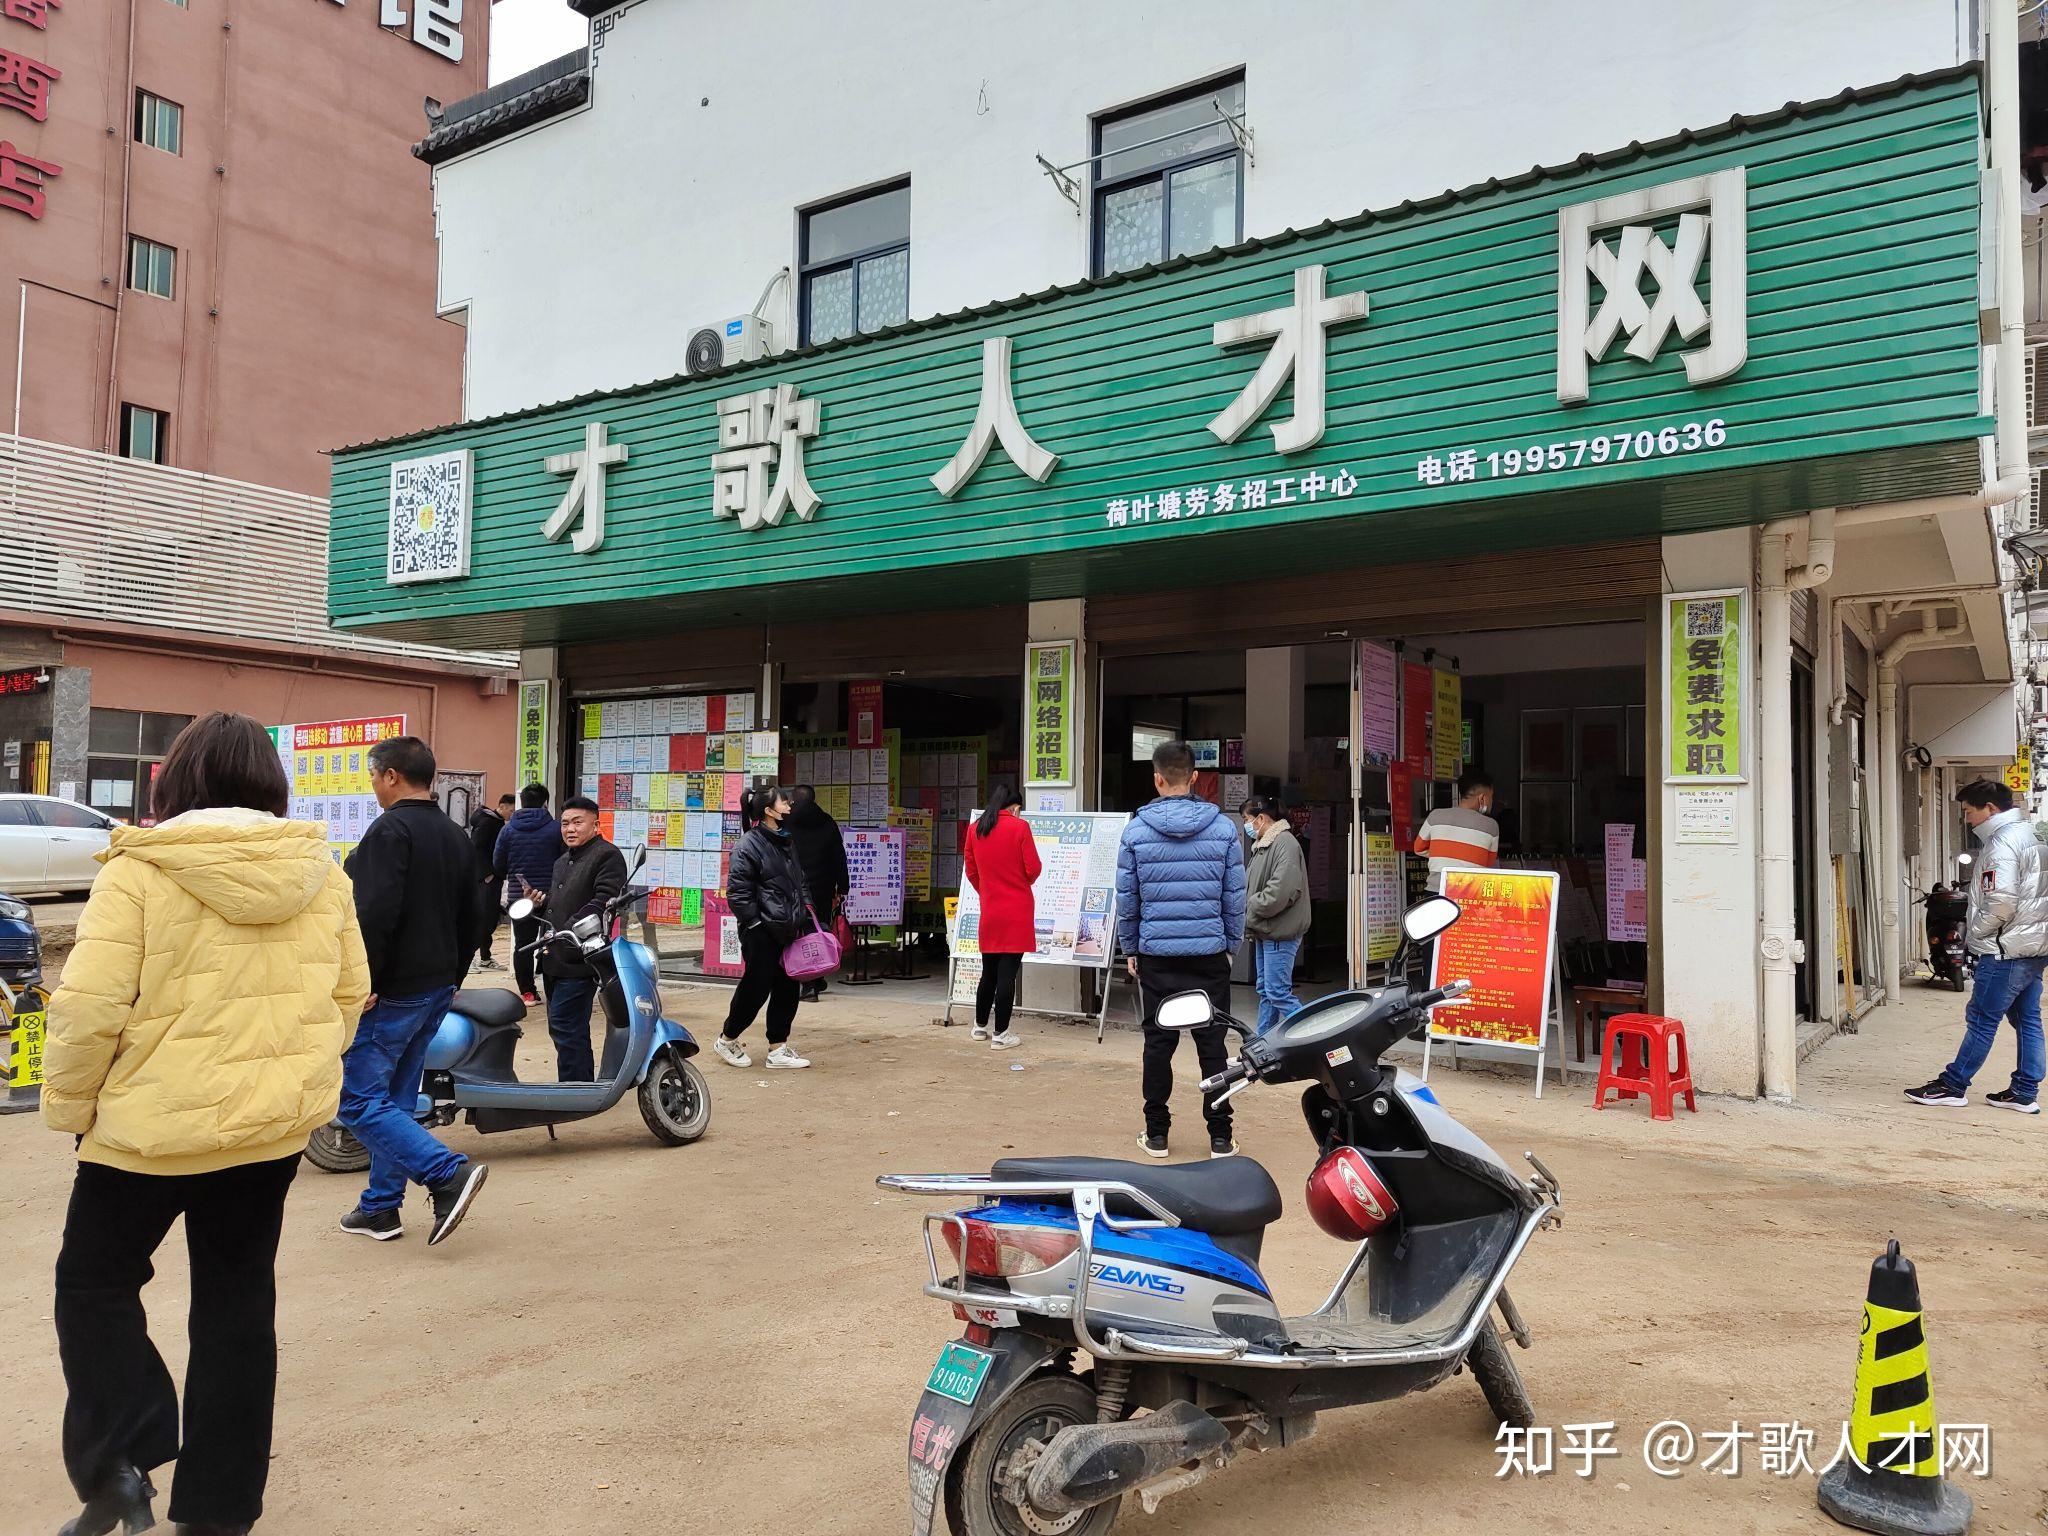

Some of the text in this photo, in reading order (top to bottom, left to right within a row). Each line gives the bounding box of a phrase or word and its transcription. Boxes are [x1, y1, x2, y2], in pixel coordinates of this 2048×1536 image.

[540, 166, 1747, 553] 才歌人才网
[1417, 419, 1727, 486] 电话 19957970636
[1106, 468, 1359, 527] 荷叶塘劳务招工中心
[1036, 681, 1062, 779] 网络招聘
[1686, 639, 1726, 775] 免费求职
[1482, 881, 1514, 899] 招聘
[26, 1031, 43, 1081] 禁止停车
[934, 1367, 974, 1396] 919103
[912, 1413, 956, 1471] 恒光
